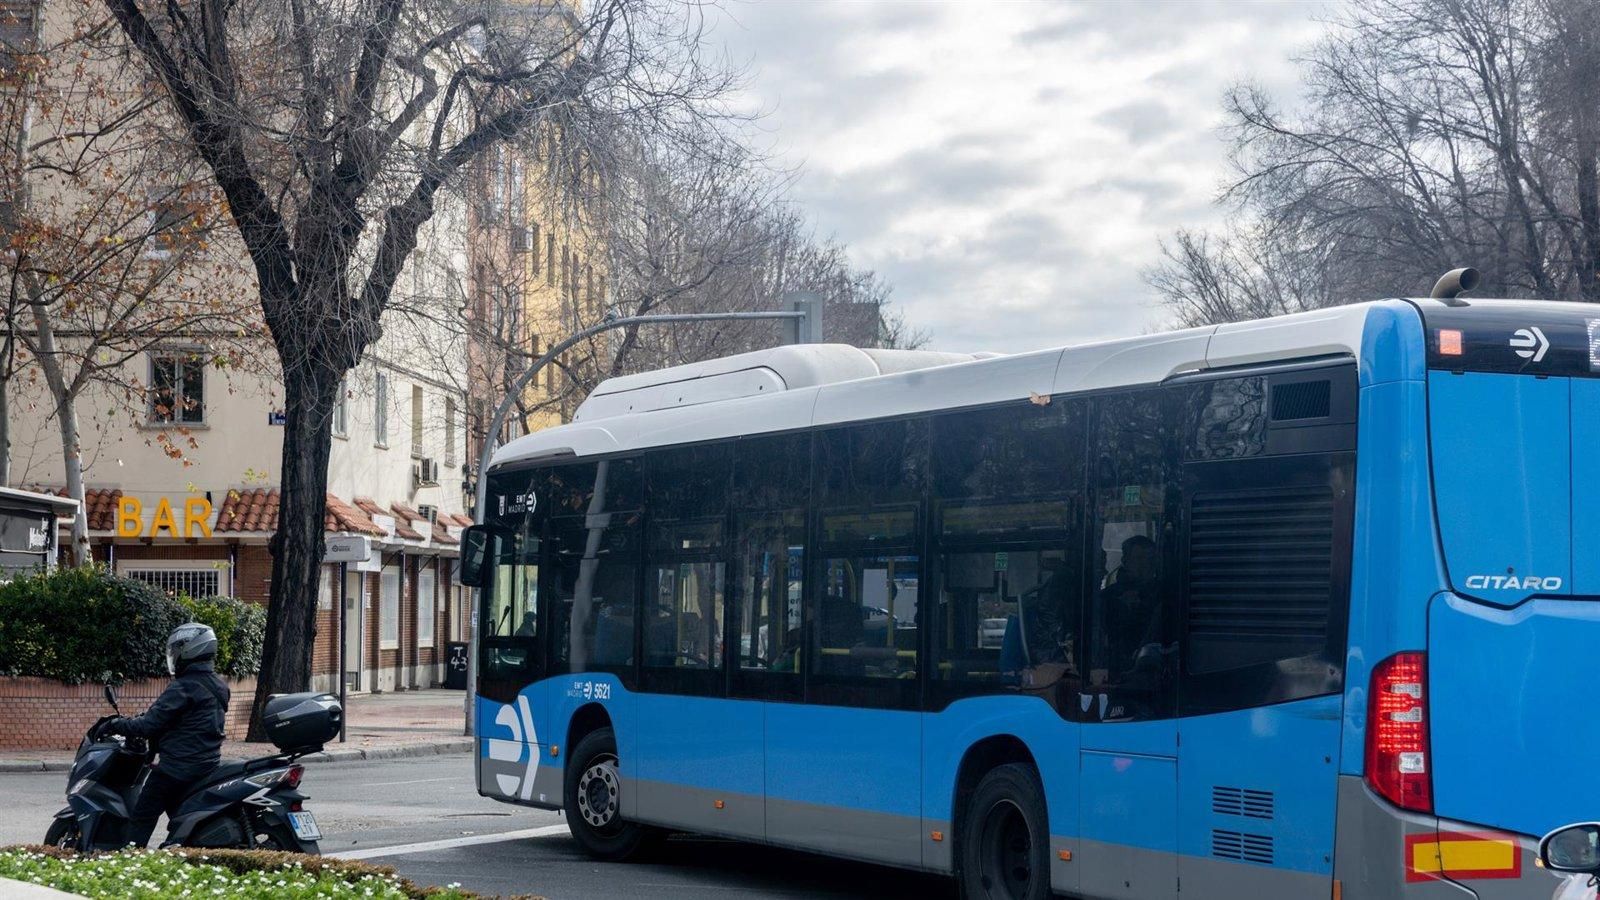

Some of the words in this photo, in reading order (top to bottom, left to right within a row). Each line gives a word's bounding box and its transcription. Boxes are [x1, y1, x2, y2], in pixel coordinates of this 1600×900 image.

[118, 496, 213, 540] BAR
[1465, 575, 1562, 590] CITARO
[453, 646, 464, 657] T
[594, 683, 611, 699] 5621
